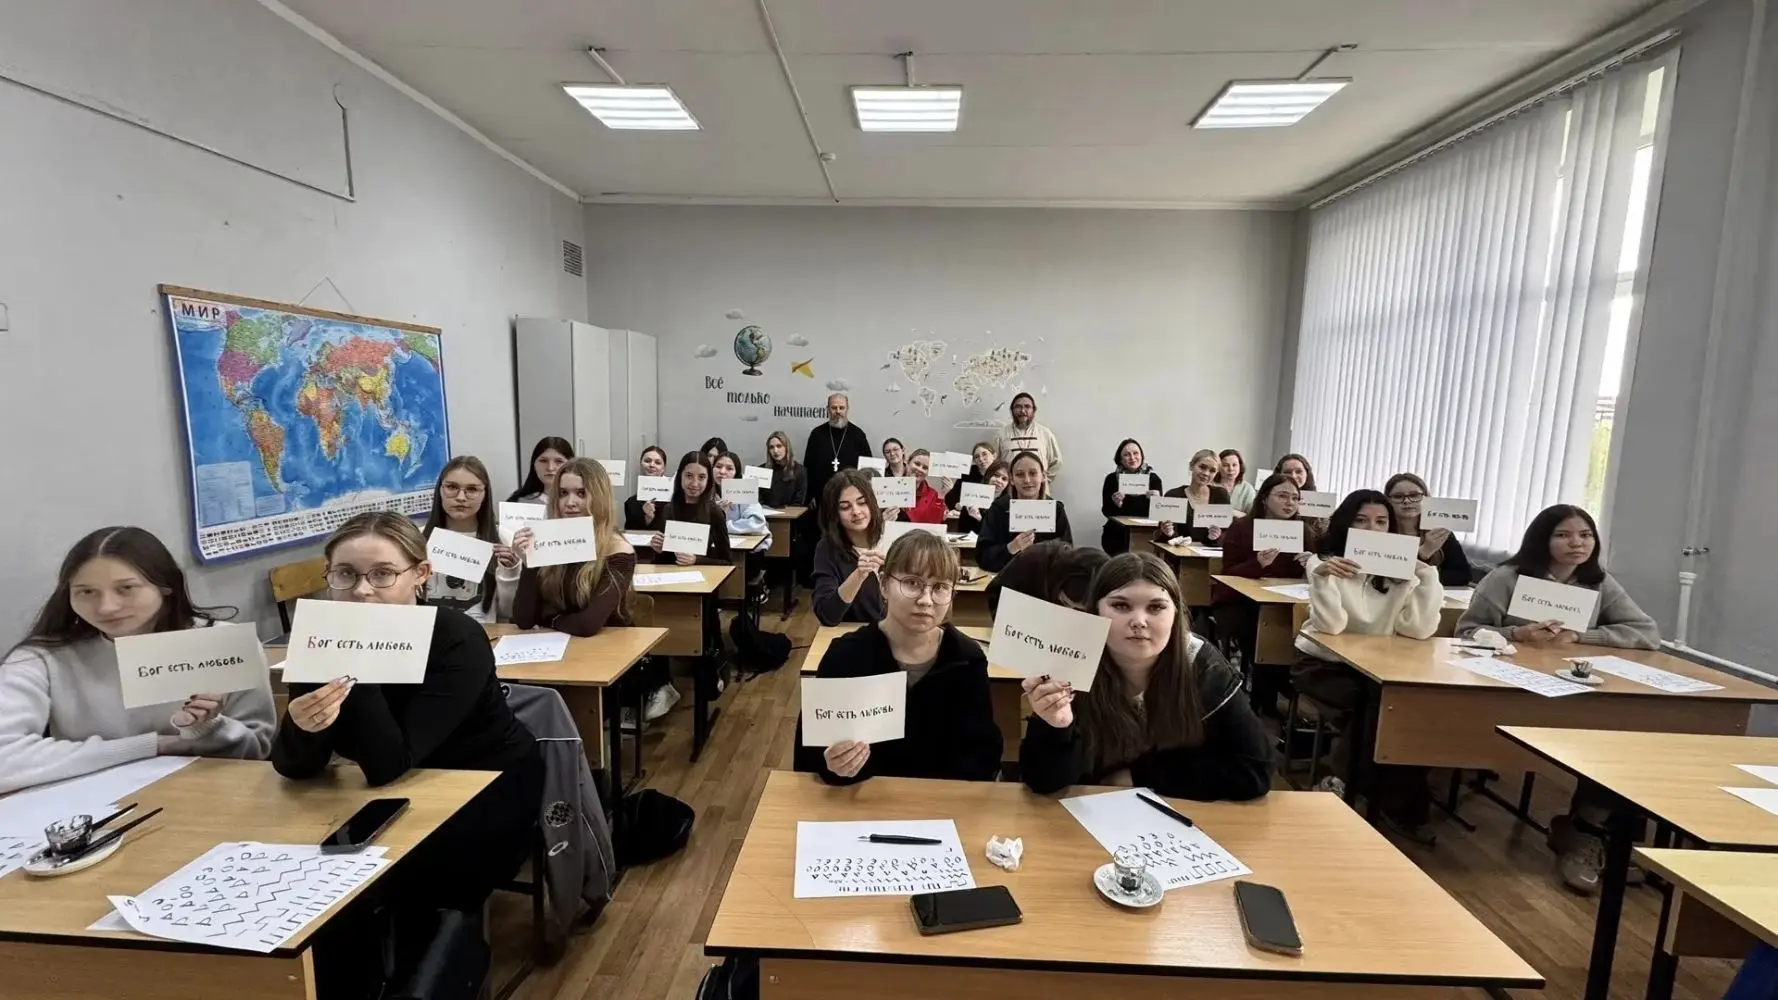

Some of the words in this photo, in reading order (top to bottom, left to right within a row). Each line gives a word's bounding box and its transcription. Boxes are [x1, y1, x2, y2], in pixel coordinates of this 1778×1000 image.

[181, 303, 220, 319] МИР
[726, 391, 771, 405] только
[307, 635, 333, 649] Бог
[337, 639, 363, 650] есть
[366, 641, 413, 651] любовь
[1004, 624, 1023, 639] Бог
[1024, 634, 1044, 650] есть
[137, 665, 163, 678] Бог
[168, 662, 194, 673] есть
[198, 656, 244, 669] любовь
[815, 708, 834, 720] Бог
[836, 710, 857, 719] есть
[859, 705, 893, 718] любовь
